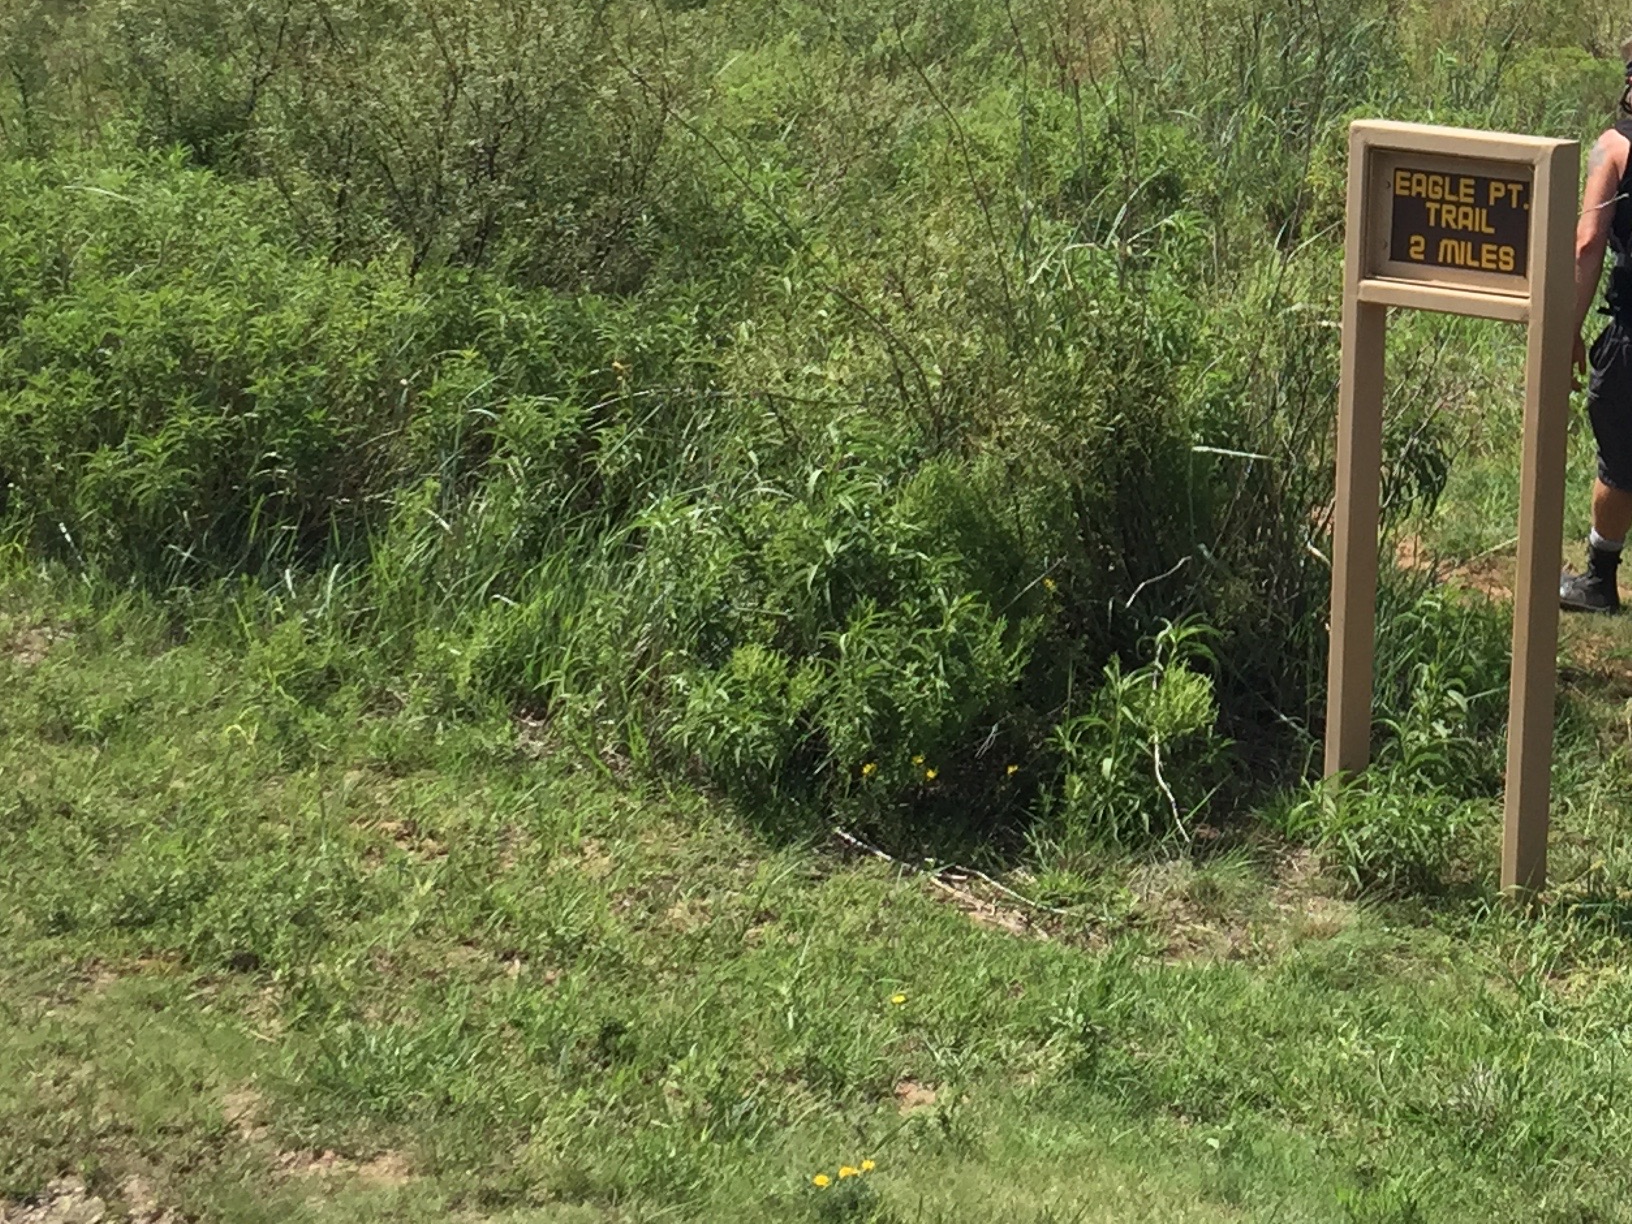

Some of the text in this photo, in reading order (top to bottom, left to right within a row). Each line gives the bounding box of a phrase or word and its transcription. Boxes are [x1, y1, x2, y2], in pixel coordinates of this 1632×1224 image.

[1395, 171, 1530, 210] EAGLE PT.
[1425, 202, 1496, 234] TRAIL
[1409, 235, 1515, 272] 2 MILES
